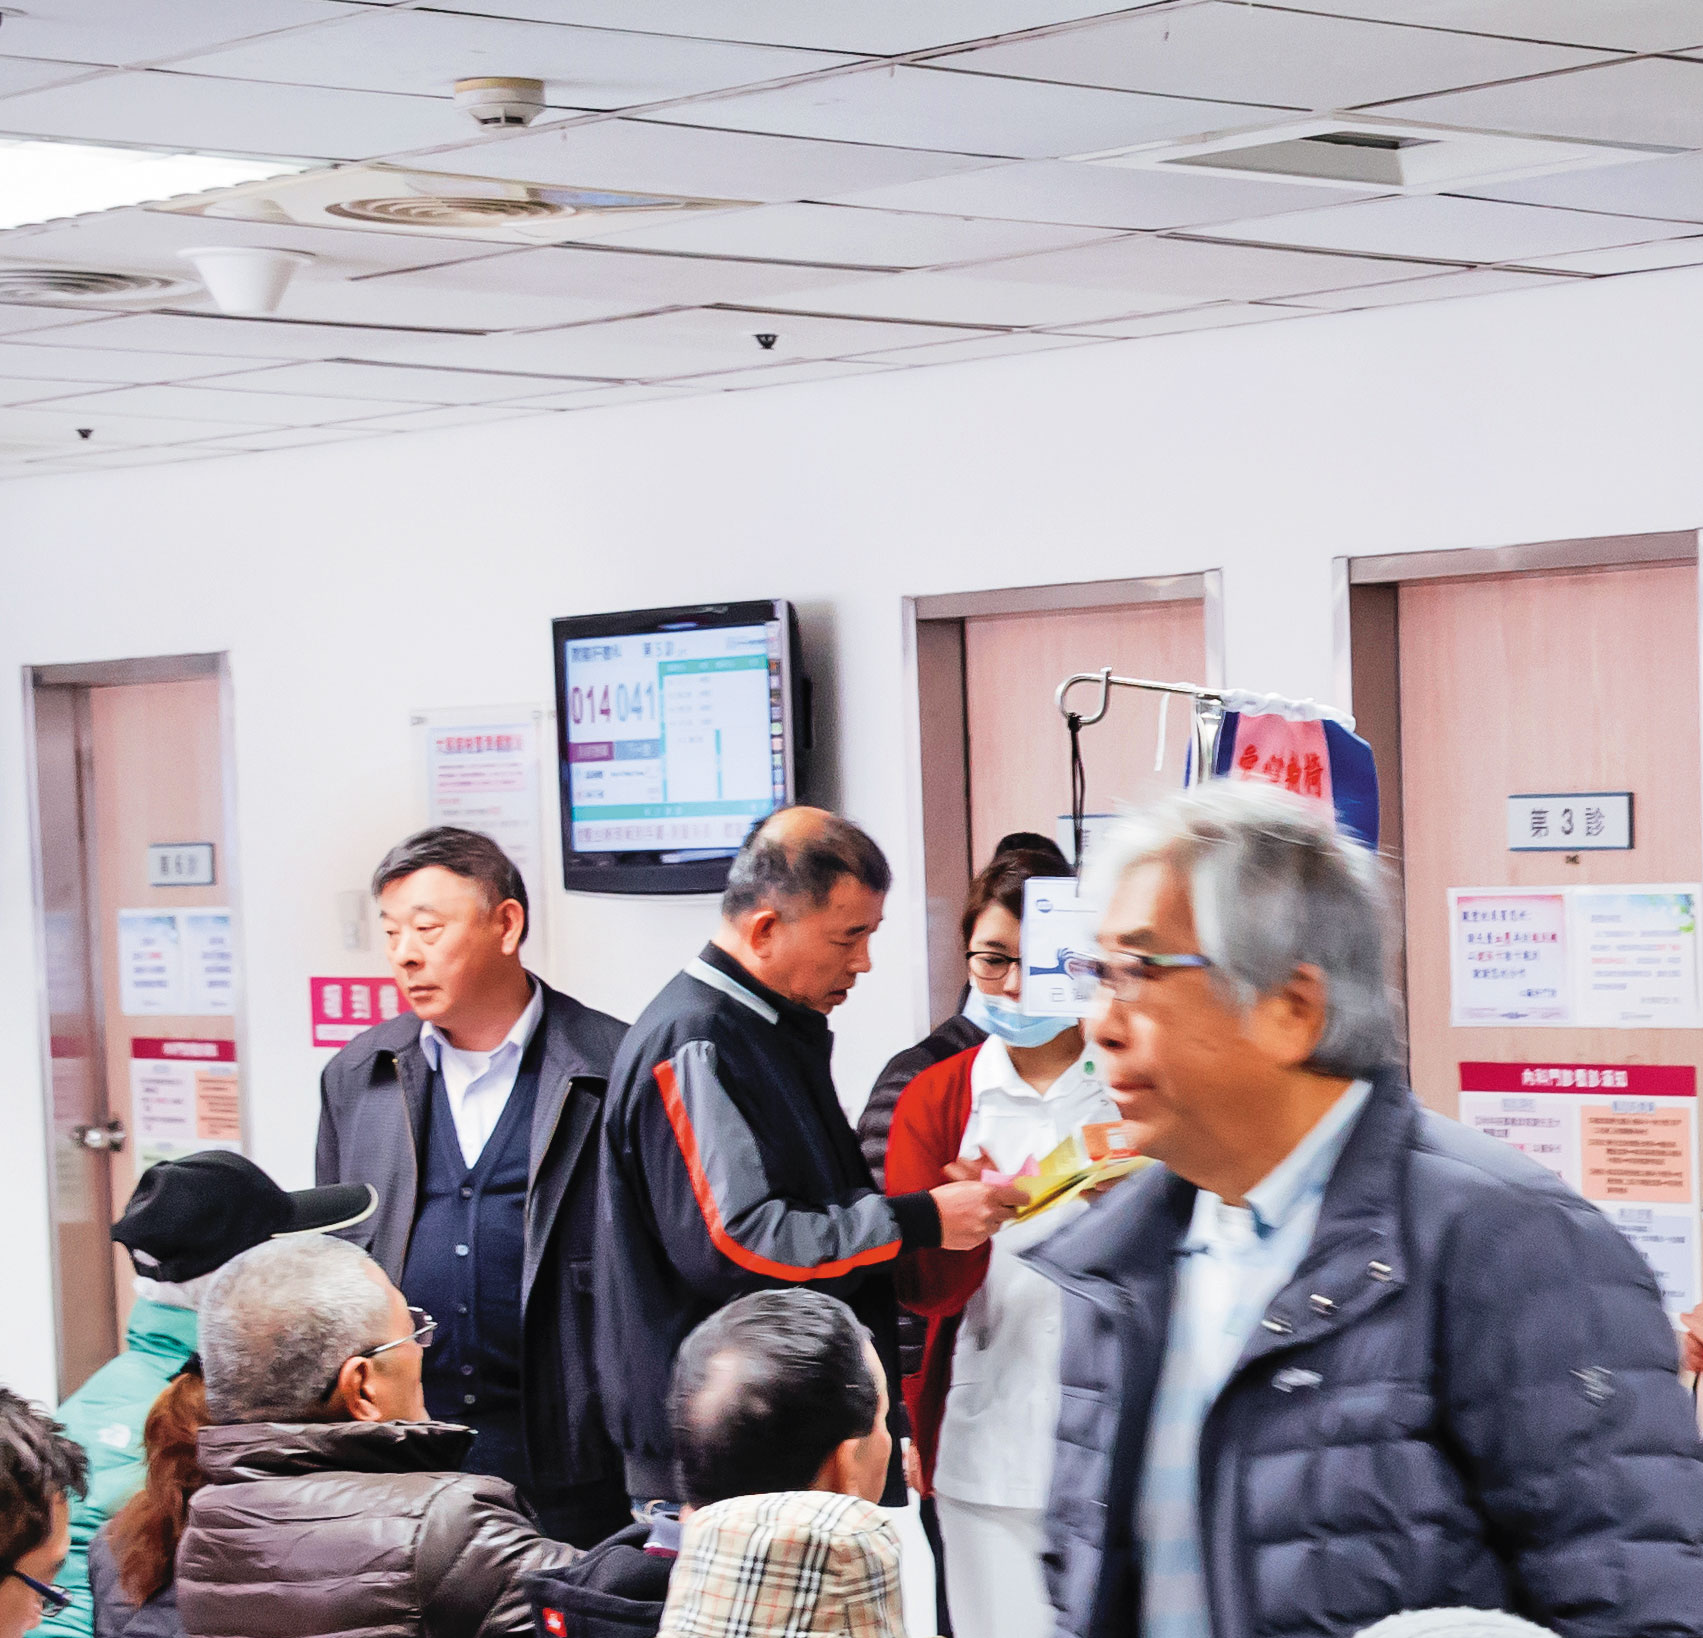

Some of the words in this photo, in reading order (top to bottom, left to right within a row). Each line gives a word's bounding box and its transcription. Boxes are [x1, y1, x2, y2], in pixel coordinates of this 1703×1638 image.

[570, 684, 612, 725] 014
[615, 681, 656, 722] 041
[1529, 806, 1606, 838] 第3診
